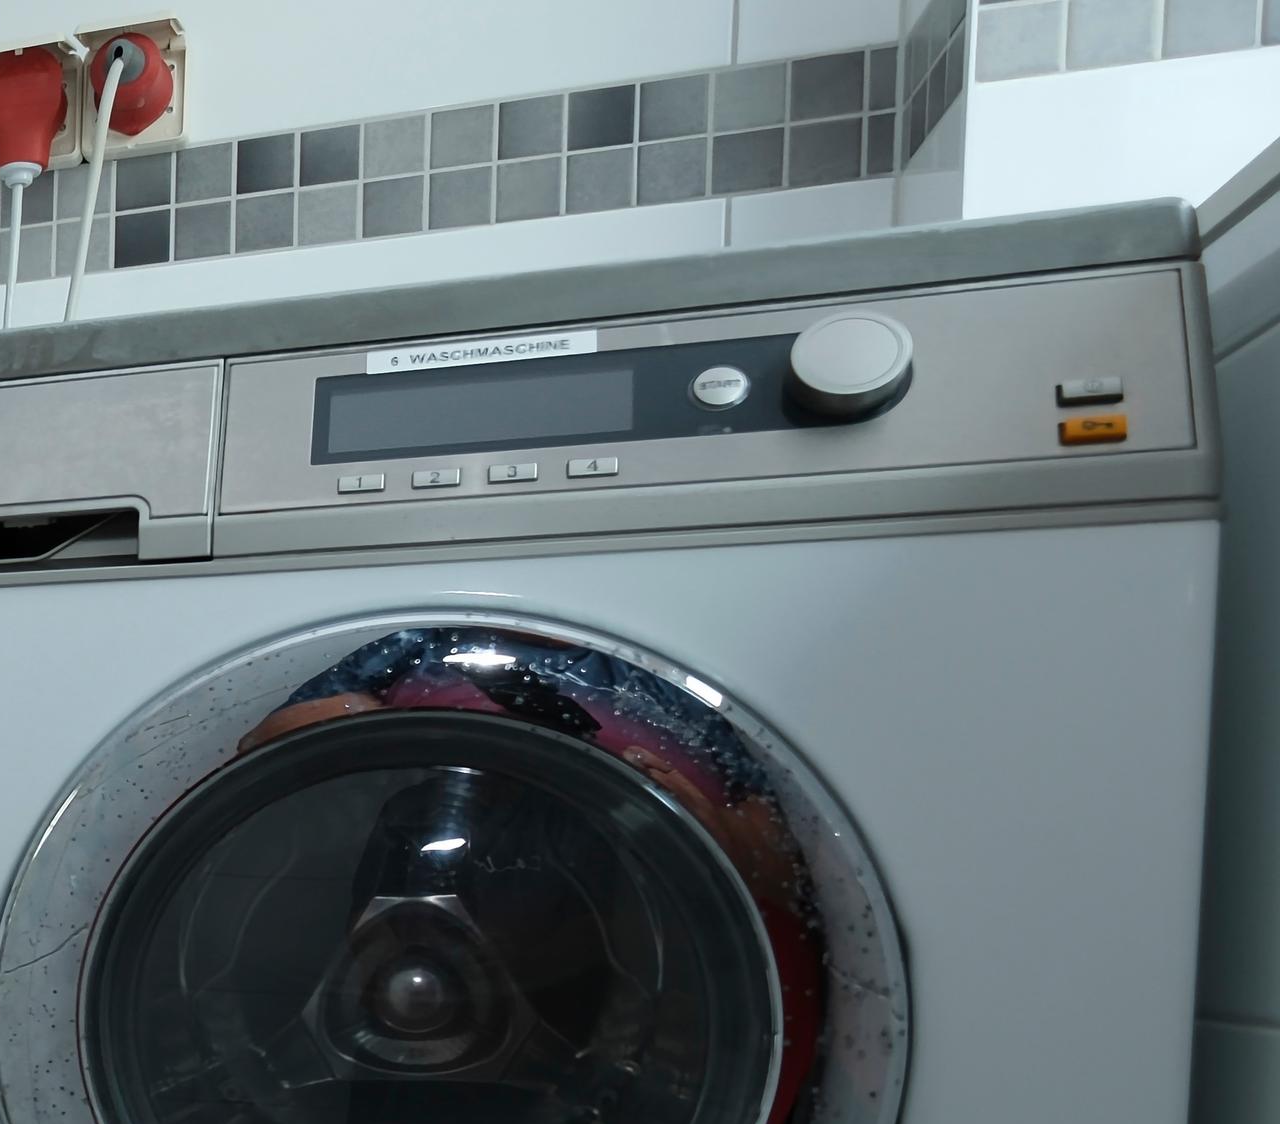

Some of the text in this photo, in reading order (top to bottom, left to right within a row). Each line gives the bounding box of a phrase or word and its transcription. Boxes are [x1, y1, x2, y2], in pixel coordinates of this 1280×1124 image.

[390, 339, 571, 366] 6 WASCHMASCHINE
[506, 465, 517, 478] 3
[586, 460, 598, 472] 4
[429, 471, 441, 484] 2
